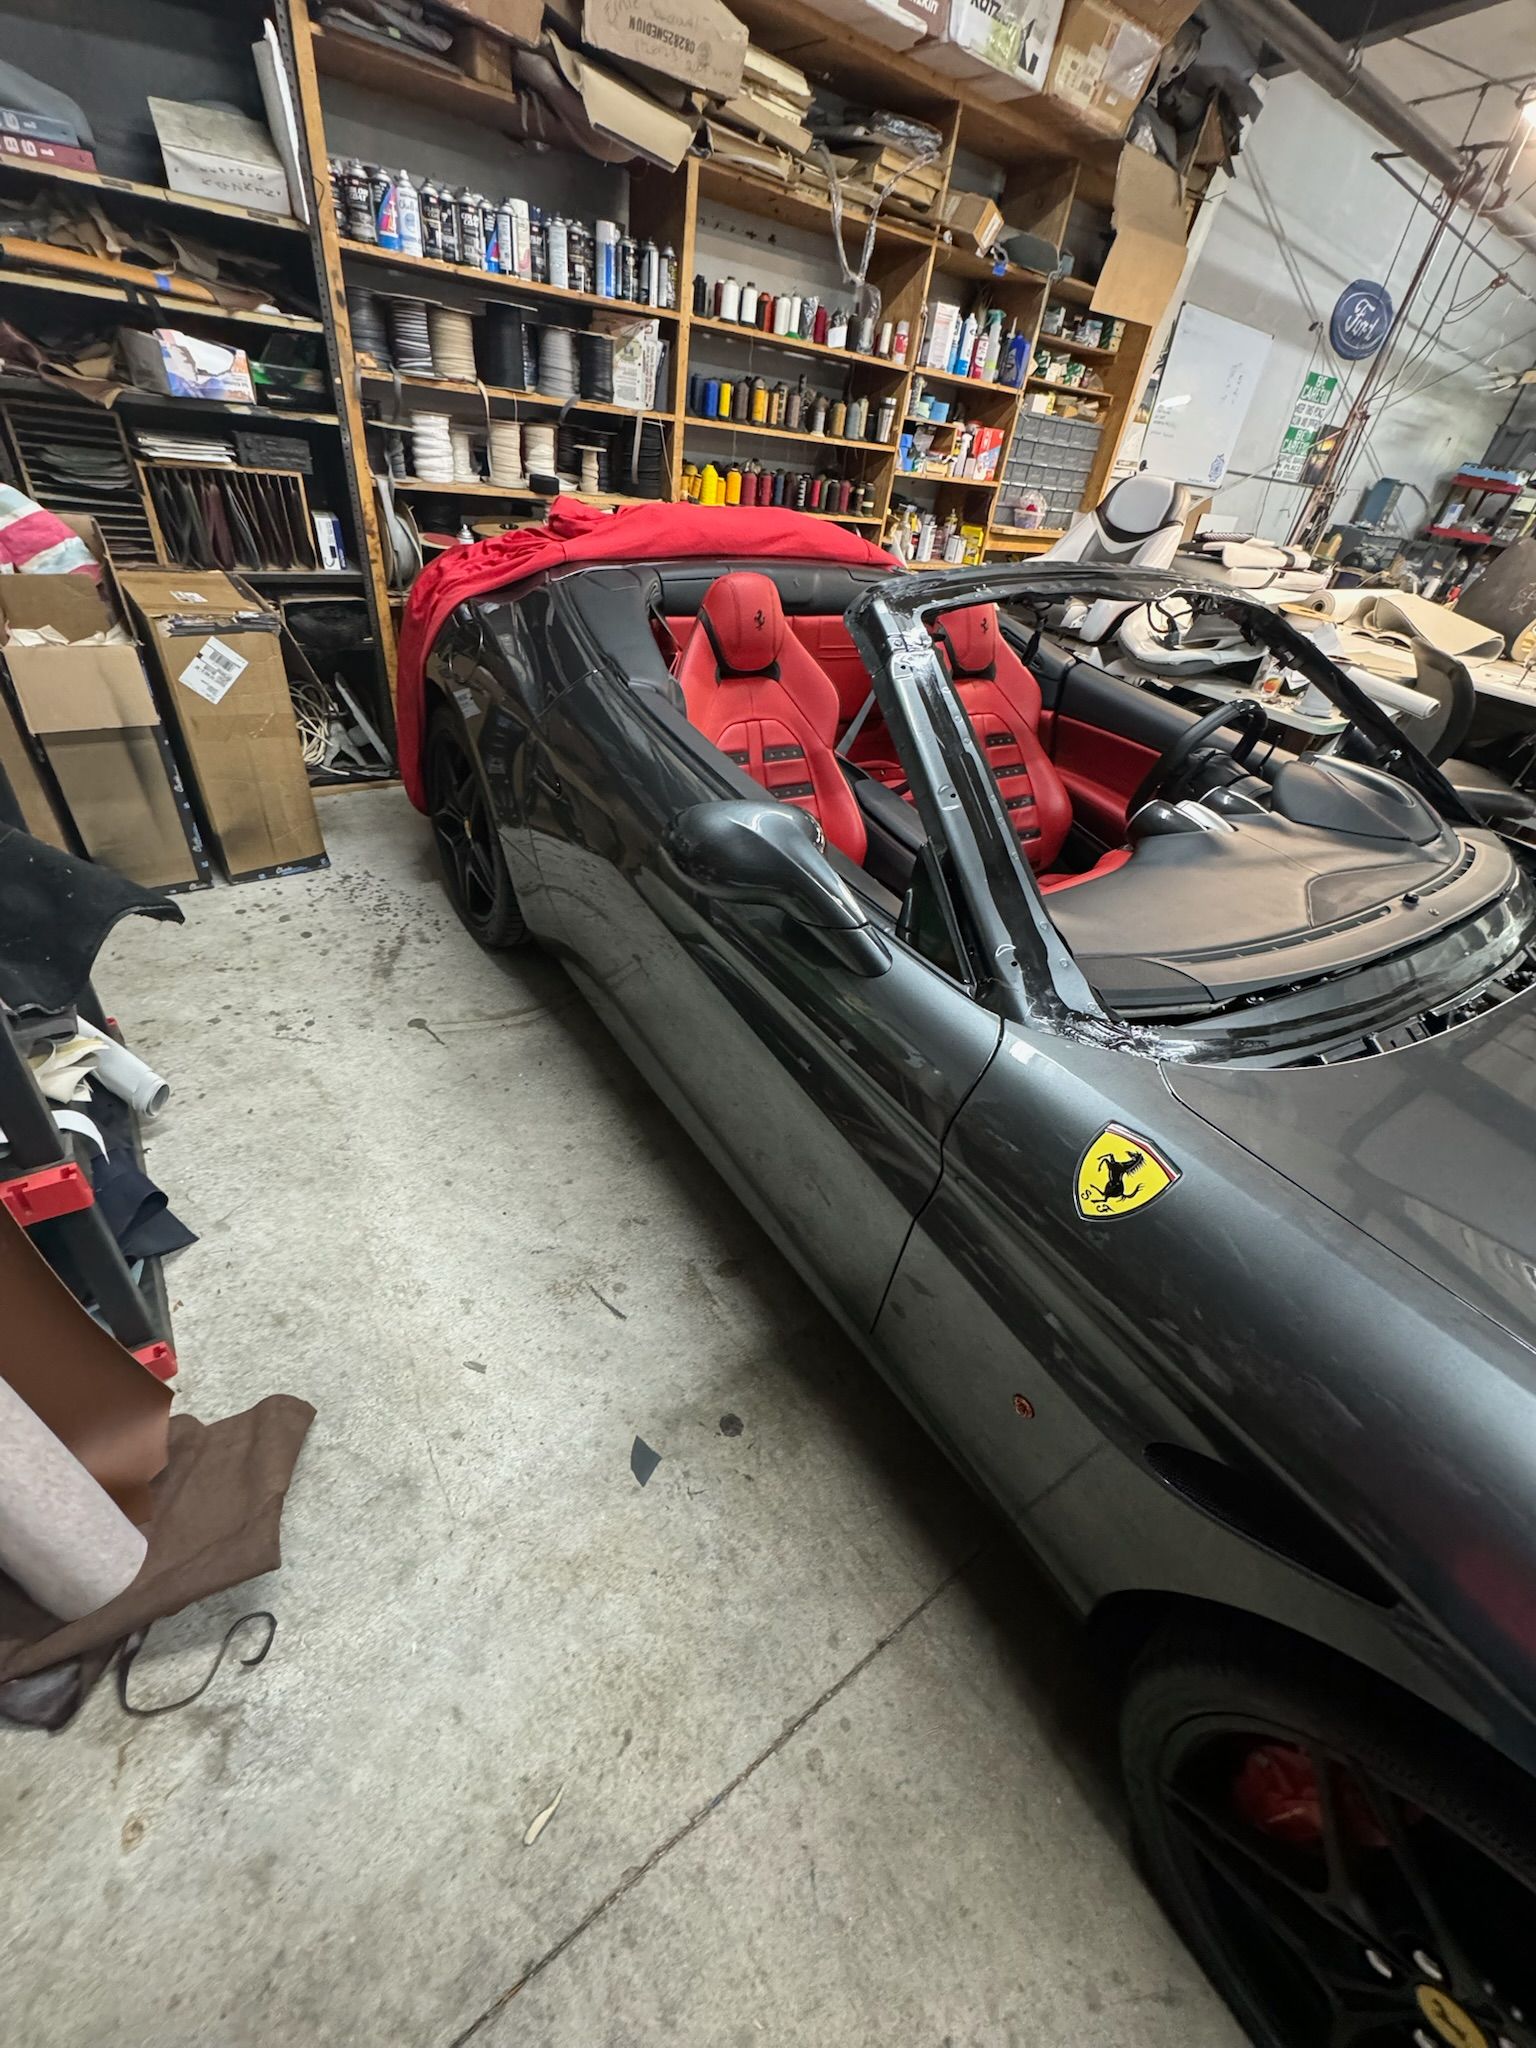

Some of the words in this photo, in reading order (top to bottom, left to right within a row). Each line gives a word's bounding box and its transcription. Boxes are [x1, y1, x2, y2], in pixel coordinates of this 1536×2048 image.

[1345, 298, 1379, 341] Ford
[1315, 375, 1329, 388] BE
[1081, 1189, 1092, 1200] S
